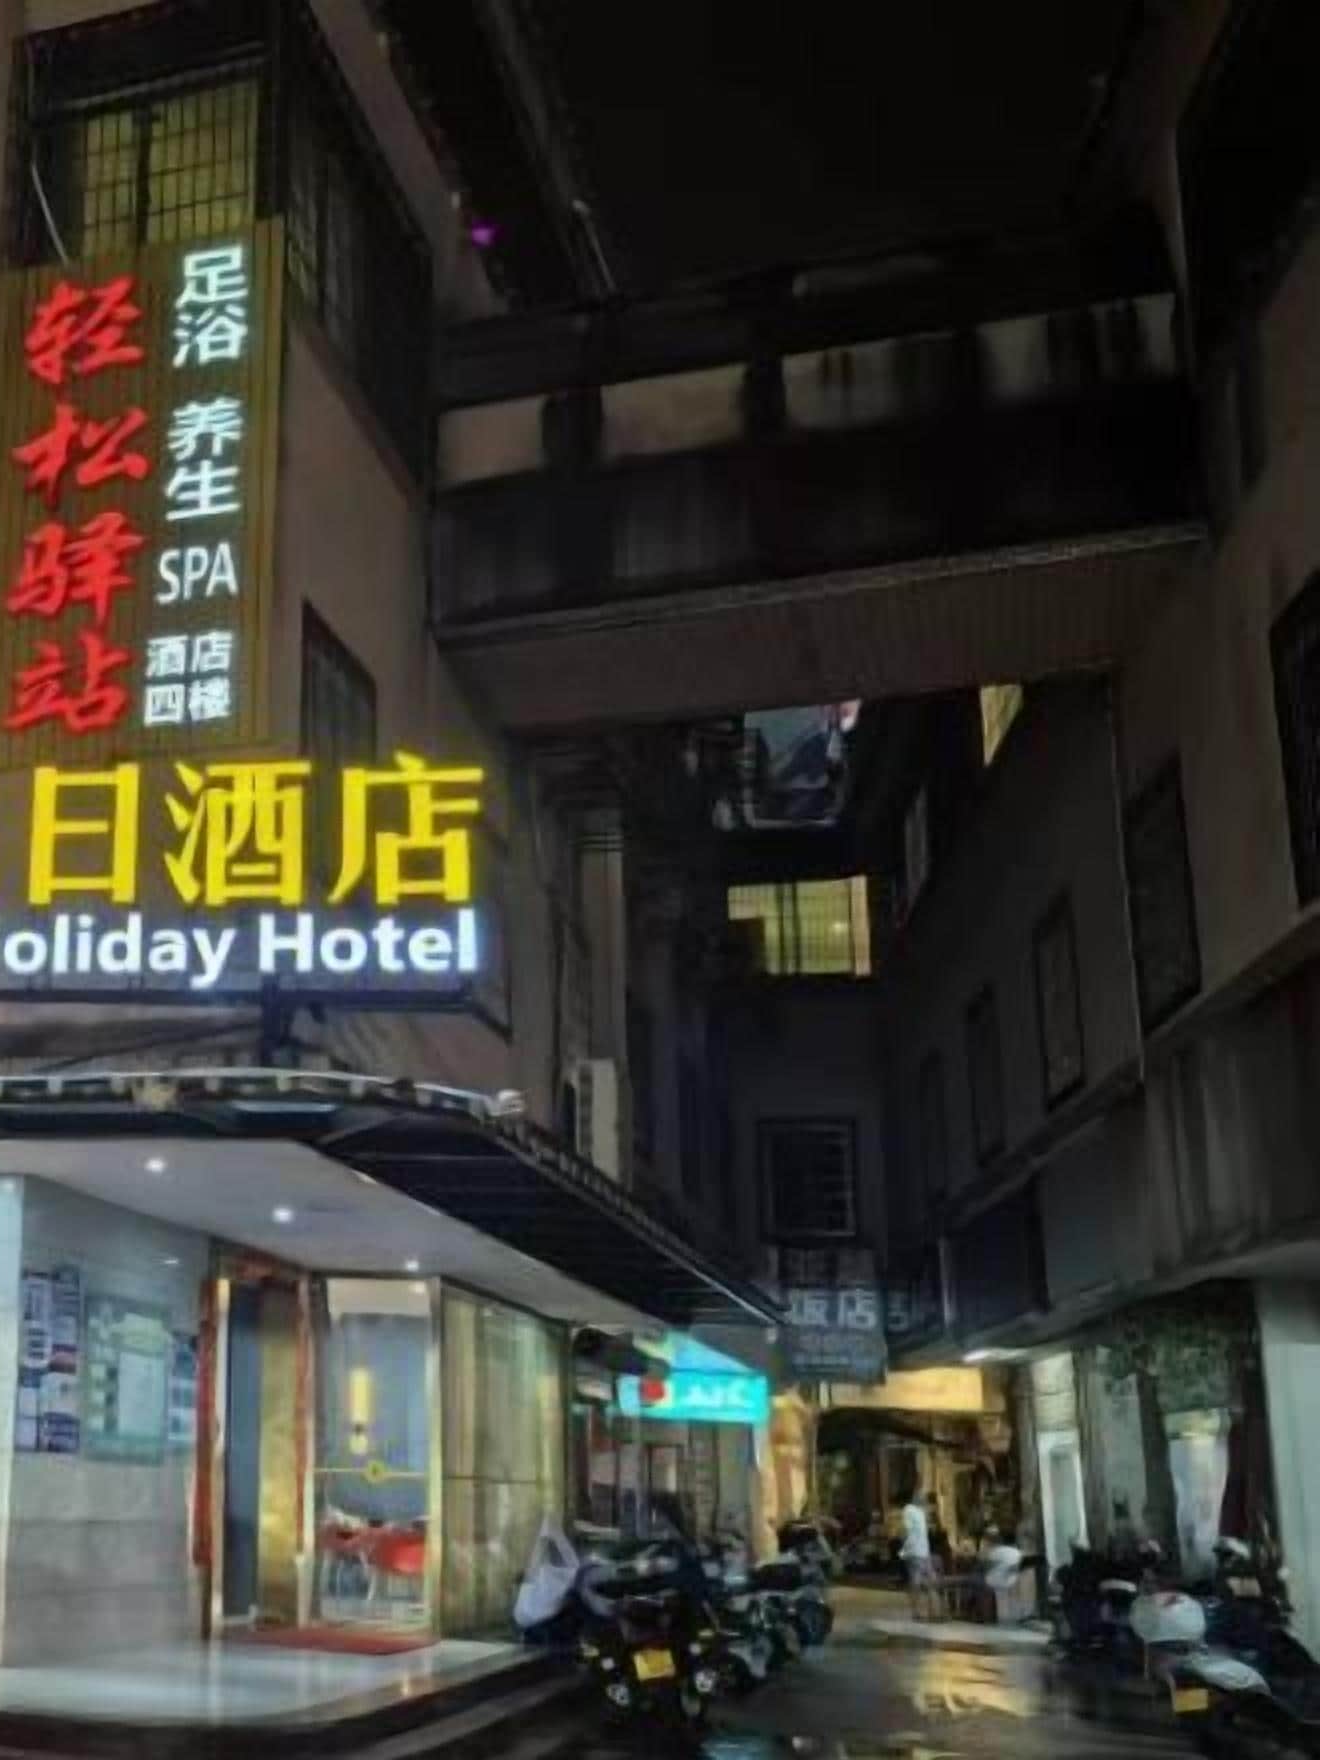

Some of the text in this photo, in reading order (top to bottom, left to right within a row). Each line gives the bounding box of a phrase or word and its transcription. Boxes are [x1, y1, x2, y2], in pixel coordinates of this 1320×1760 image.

[164, 246, 248, 521] 足浴 养生
[3, 276, 151, 735] 轻松驿站
[155, 543, 238, 604] SPA
[145, 631, 233, 678] 酒店
[258, 909, 479, 973] Hotel
